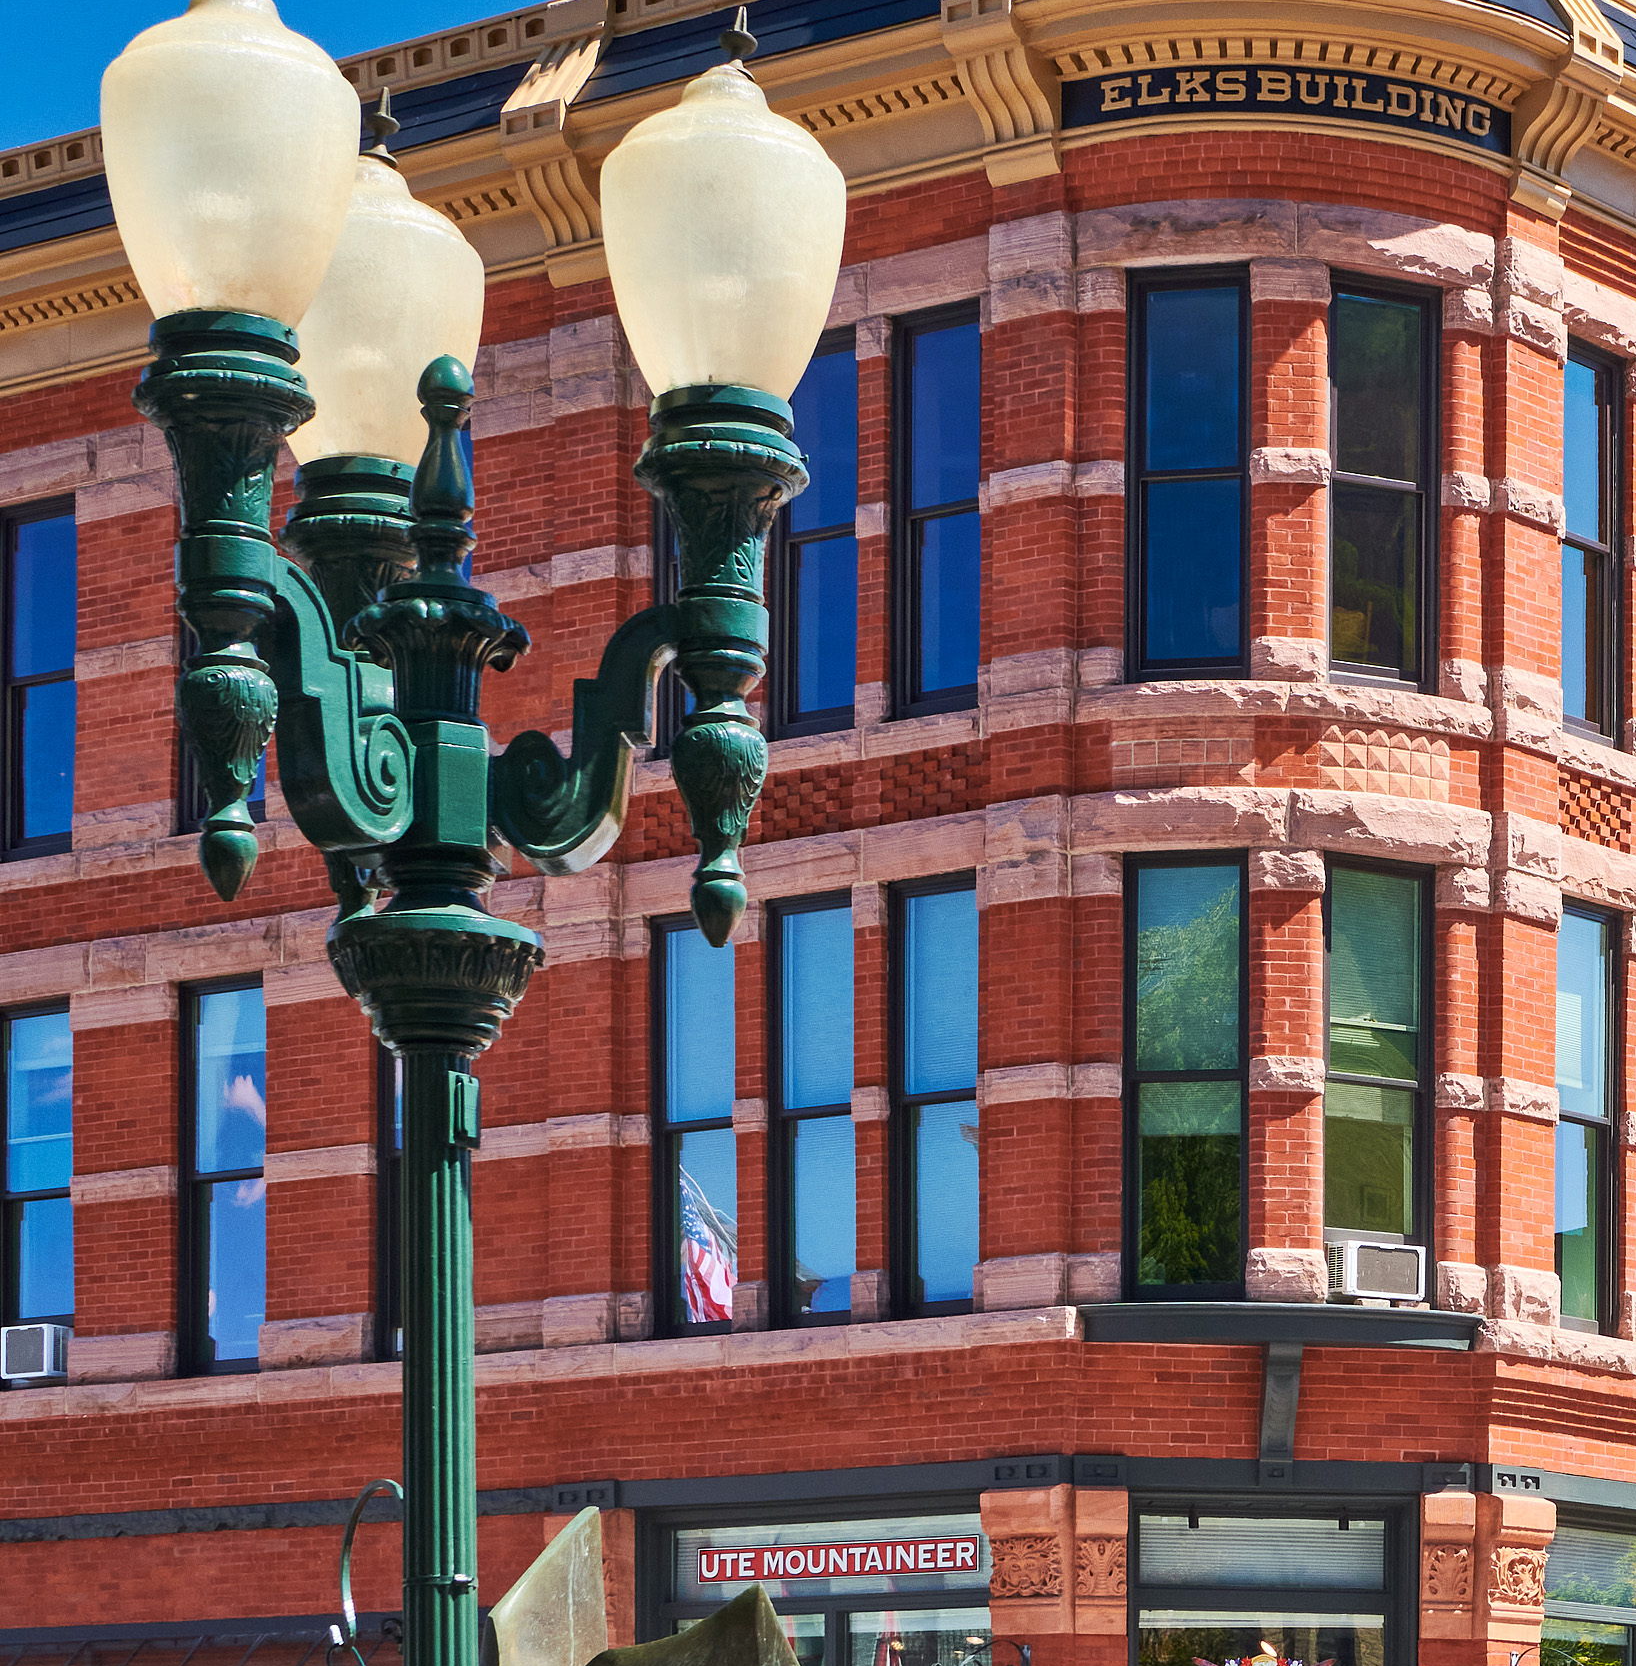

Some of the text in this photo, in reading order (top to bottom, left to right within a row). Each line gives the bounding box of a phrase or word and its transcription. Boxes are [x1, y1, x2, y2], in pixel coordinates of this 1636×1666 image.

[1100, 71, 1492, 137] ELKS BUILDING
[701, 1541, 975, 1579] UTE MOUNTAINEER
